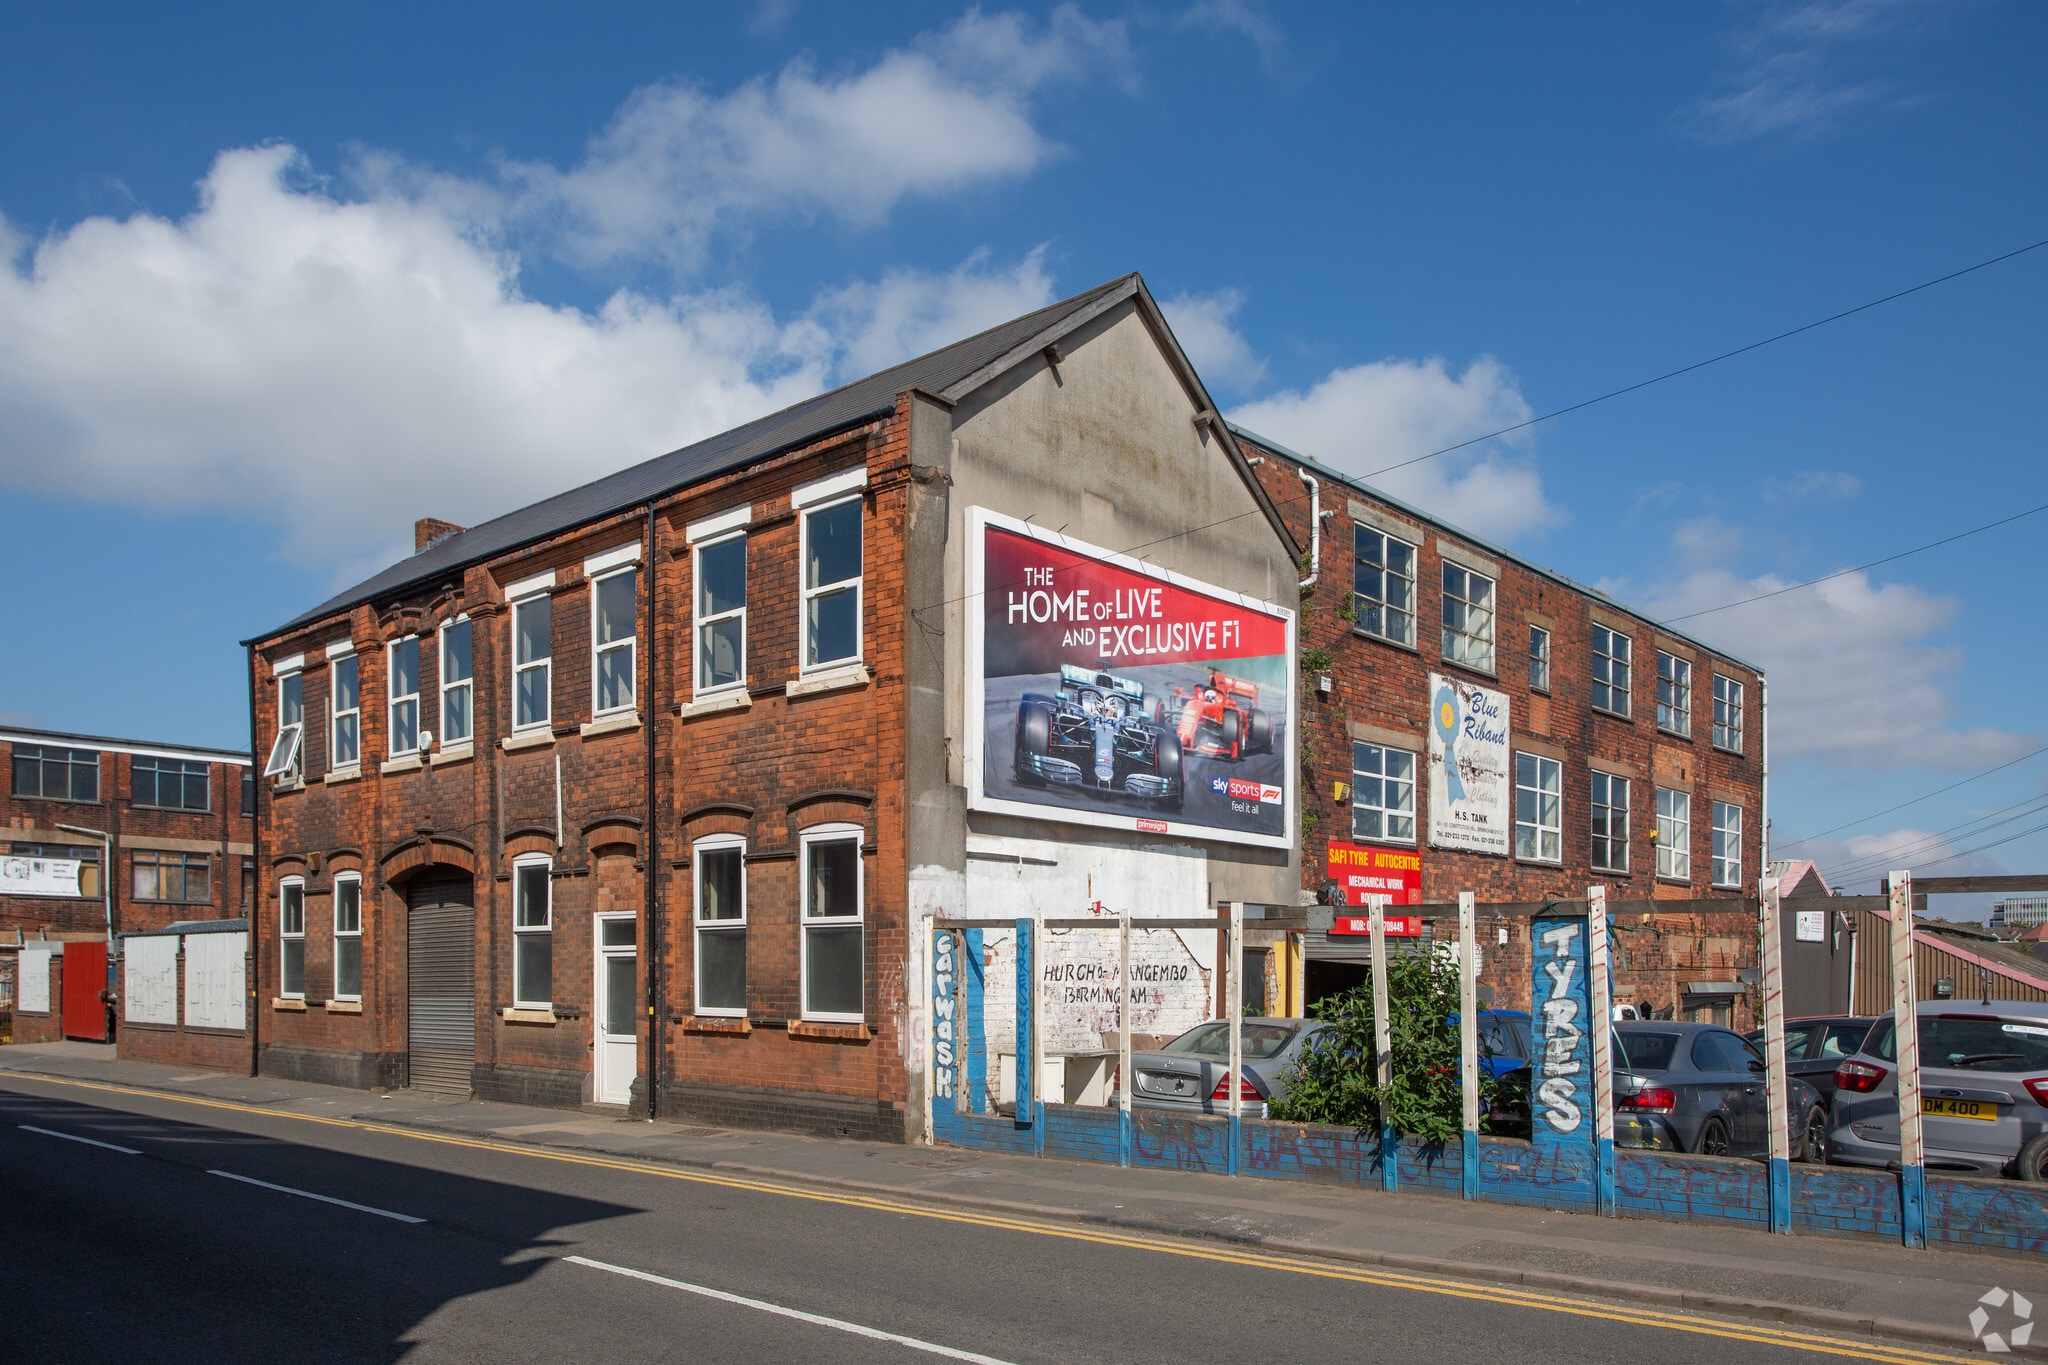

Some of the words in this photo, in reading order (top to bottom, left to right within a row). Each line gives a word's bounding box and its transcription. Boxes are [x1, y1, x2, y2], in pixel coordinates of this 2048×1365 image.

[1024, 567, 1054, 586] THE
[1008, 590, 1090, 625] HOME
[1093, 602, 1113, 620] OF
[1115, 588, 1163, 619] LIVE
[1062, 628, 1096, 647] AND
[1099, 621, 1217, 657] EXCLUSIVE
[1222, 620, 1240, 649] F1
[1471, 691, 1499, 718] Blue
[1464, 715, 1507, 746] Riband
[1213, 777, 1229, 794] sky
[1230, 782, 1260, 797] sports
[1231, 801, 1245, 813] feel
[1245, 803, 1251, 813] it
[1251, 804, 1260, 815] all
[1471, 813, 1487, 824] TANK
[1329, 848, 1347, 865] SAFI
[1348, 849, 1369, 866] TYRE
[1374, 852, 1421, 871] AUTOCENTRE
[1348, 875, 1386, 889] MECHANICAL
[1386, 877, 1404, 890] WORK
[1350, 919, 1366, 931] MOB:
[1064, 986, 1147, 1005] BIRMINGAM
[1539, 922, 1583, 1132] TYRES
[1923, 1101, 1943, 1113] DM
[1948, 1102, 1979, 1116] 400
[1134, 1119, 1215, 1173] CAR
[1247, 1123, 1362, 1183] WASH
